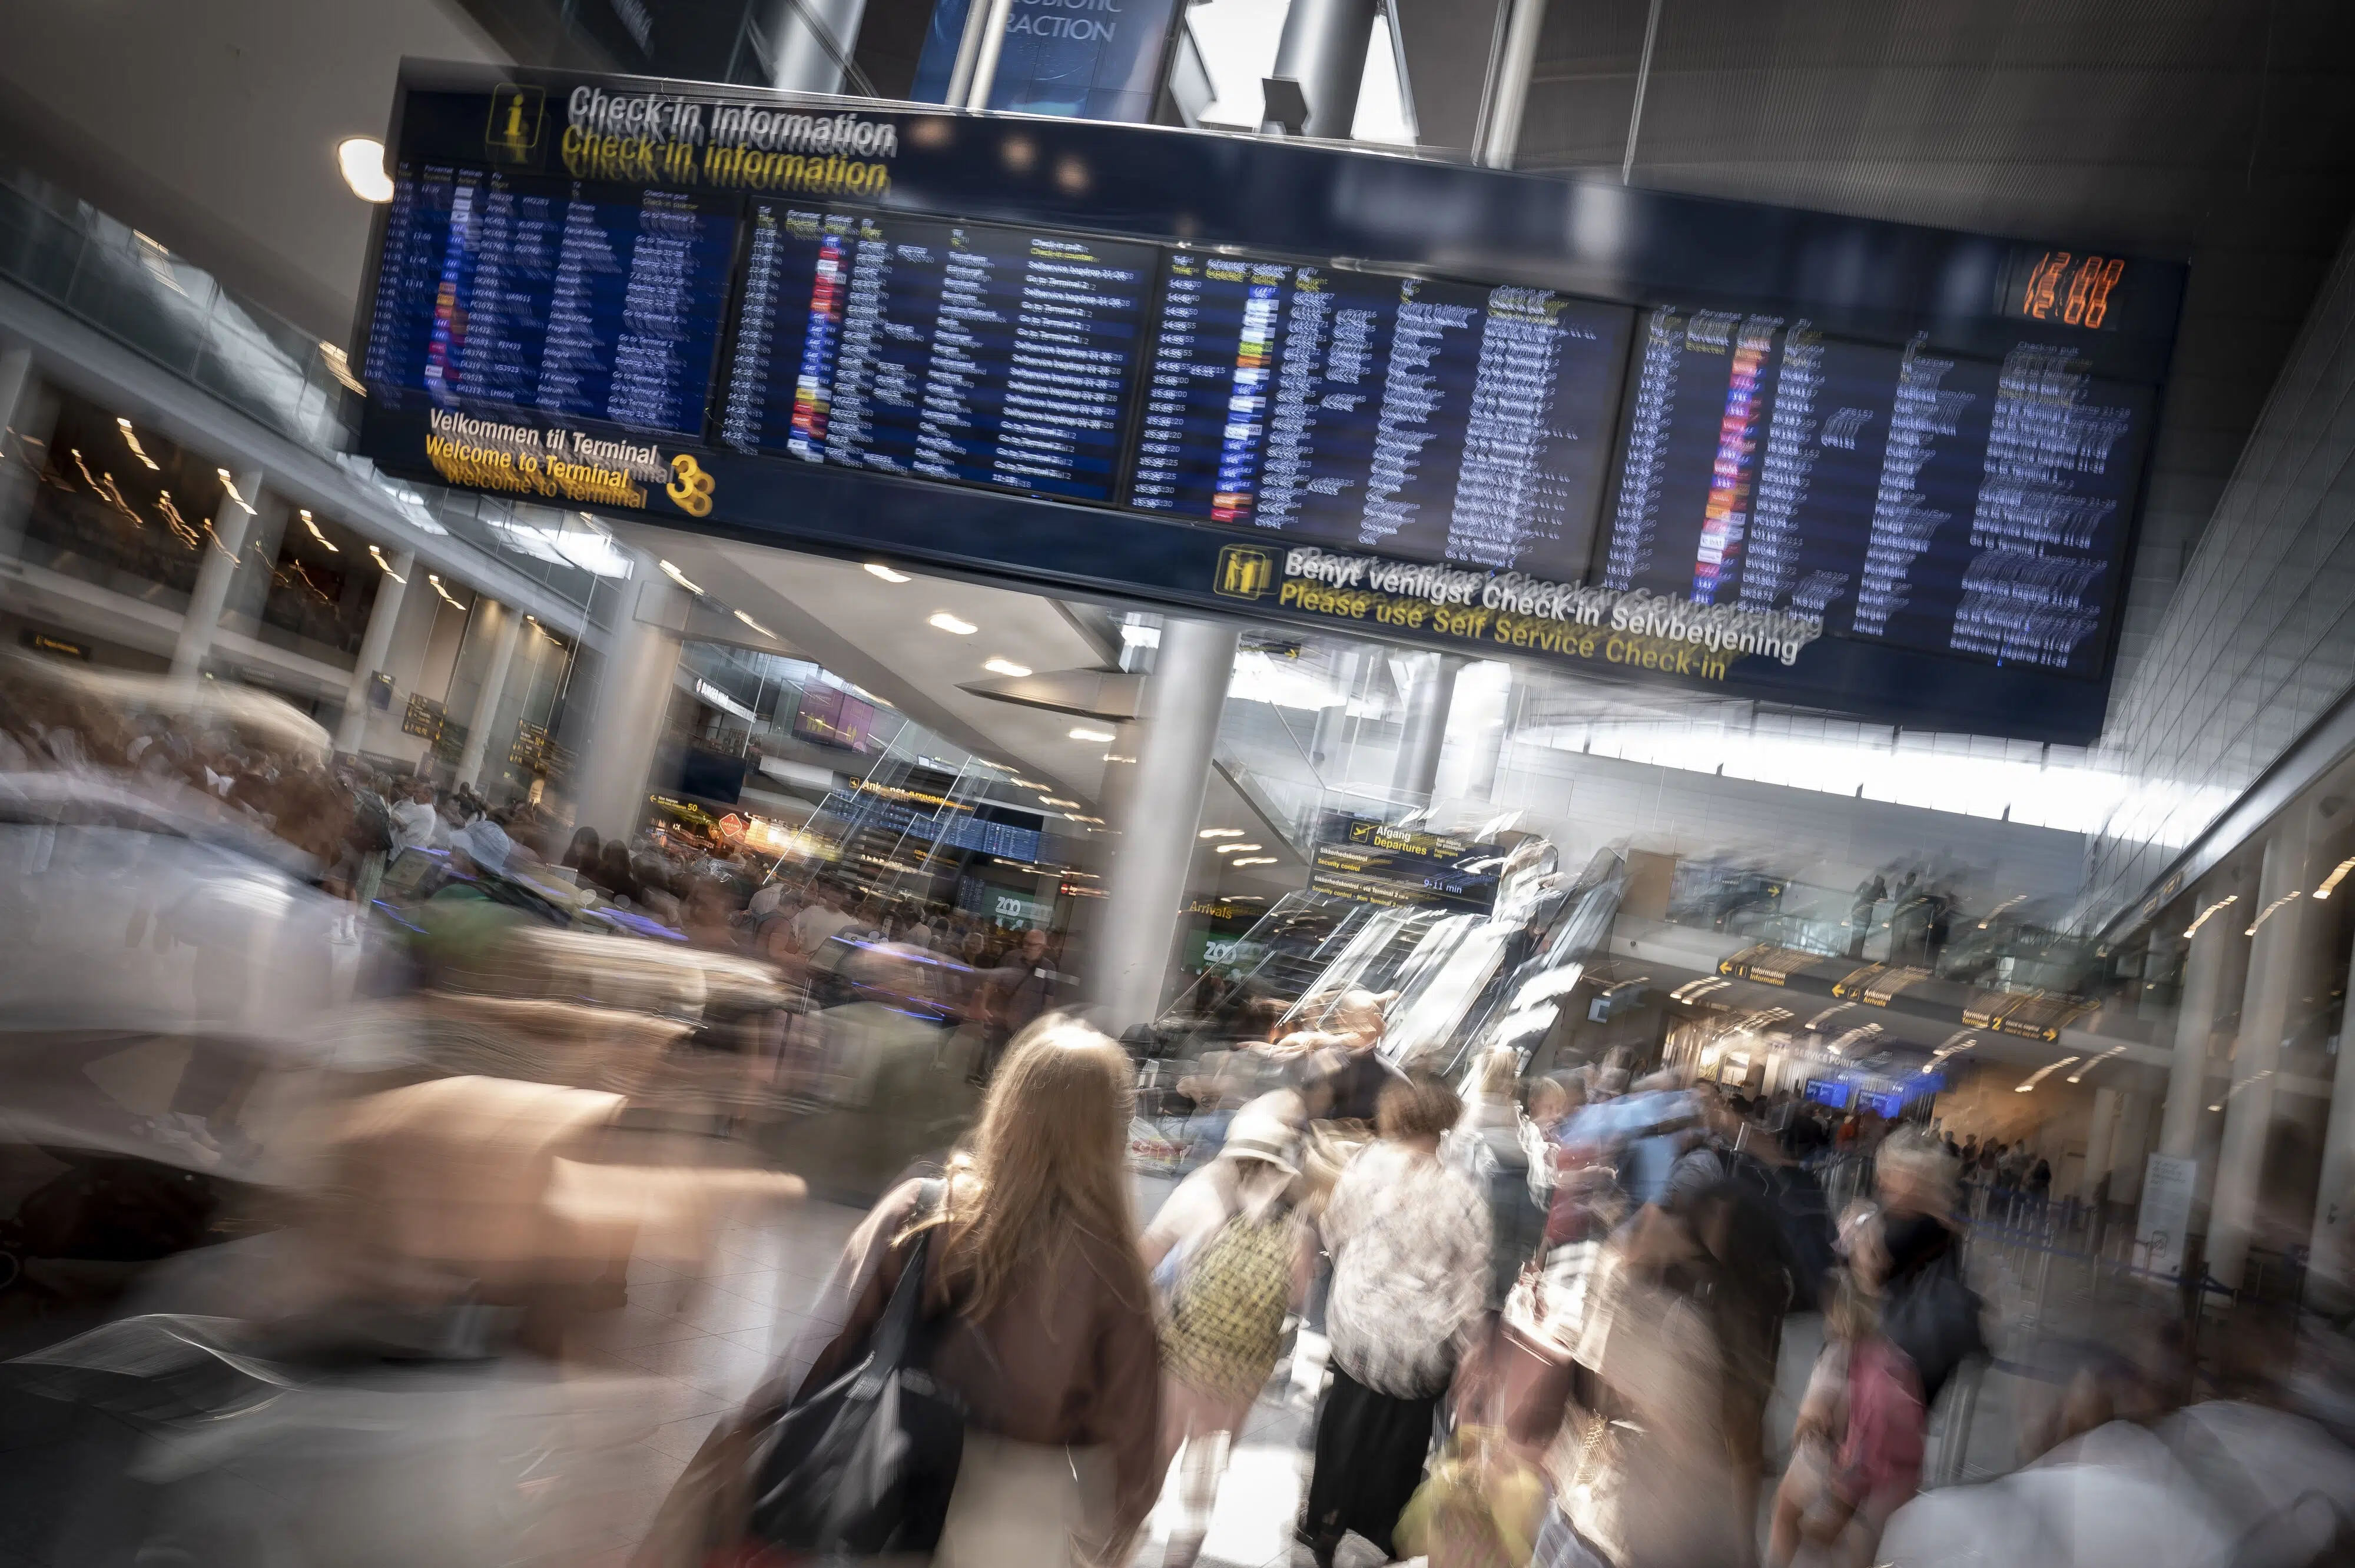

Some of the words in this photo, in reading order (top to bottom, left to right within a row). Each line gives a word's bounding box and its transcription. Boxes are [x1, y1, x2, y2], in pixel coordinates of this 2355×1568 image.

[568, 86, 703, 137] Check-in
[710, 101, 897, 150] information
[562, 124, 695, 169] Check-in
[705, 139, 890, 190] information
[426, 434, 513, 469] Welcome
[519, 451, 538, 471] to
[546, 455, 629, 489] Terminal
[430, 408, 539, 446] Velkommen
[546, 428, 566, 450] til
[572, 431, 659, 466] Terminal
[666, 454, 699, 500] 3
[1284, 552, 1361, 589] Benyt
[1369, 569, 1473, 606] venligst
[1481, 584, 1601, 627] Check-in
[1610, 606, 1799, 666] Selvbetjening
[1279, 583, 1366, 619] Please
[1376, 604, 1424, 629] use
[1432, 609, 1487, 639] Self
[1494, 619, 1595, 658] Service
[1606, 636, 1726, 681] Check-in
[688, 803, 698, 812] 50
[1376, 825, 1412, 842] Afgang
[1319, 846, 1369, 863] Sikkerhedskontrol
[1374, 836, 1428, 856] Departures
[1317, 858, 1340, 869] Security
[1341, 862, 1361, 872] control
[1314, 875, 1359, 891] Sikkerhedskontrol
[1372, 887, 1394, 898] Terminal
[1424, 877, 1444, 891] 9-11
[1446, 883, 1462, 894] min
[1312, 885, 1334, 897] Security
[1334, 889, 1352, 899] control
[1370, 897, 1392, 908] Terminal
[1189, 901, 1232, 919] Arrivals
[1750, 964, 1786, 979] Information
[1750, 973, 1785, 986] Information
